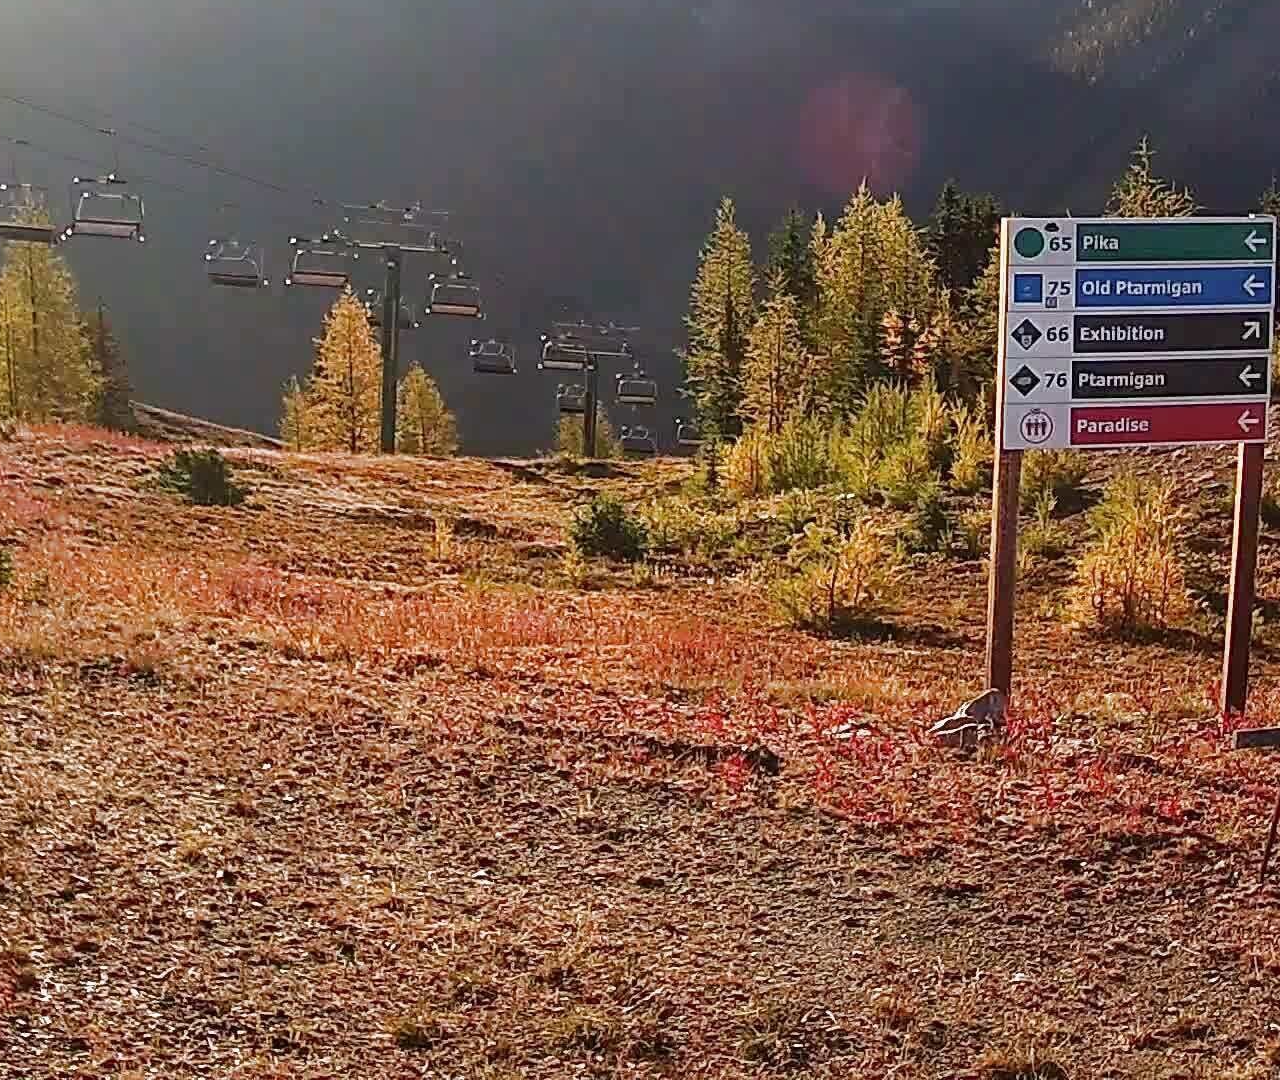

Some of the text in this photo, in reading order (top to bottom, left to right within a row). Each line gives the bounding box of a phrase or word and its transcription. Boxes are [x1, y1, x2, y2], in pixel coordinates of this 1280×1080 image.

[1048, 235, 1119, 252] 65 Pika
[1047, 279, 1202, 297] 75 Old Ptarmigan
[1046, 326, 1164, 342] 66 Exhibition
[1044, 371, 1165, 390] 76 Ptarmigan
[1077, 417, 1149, 433] Paradise
